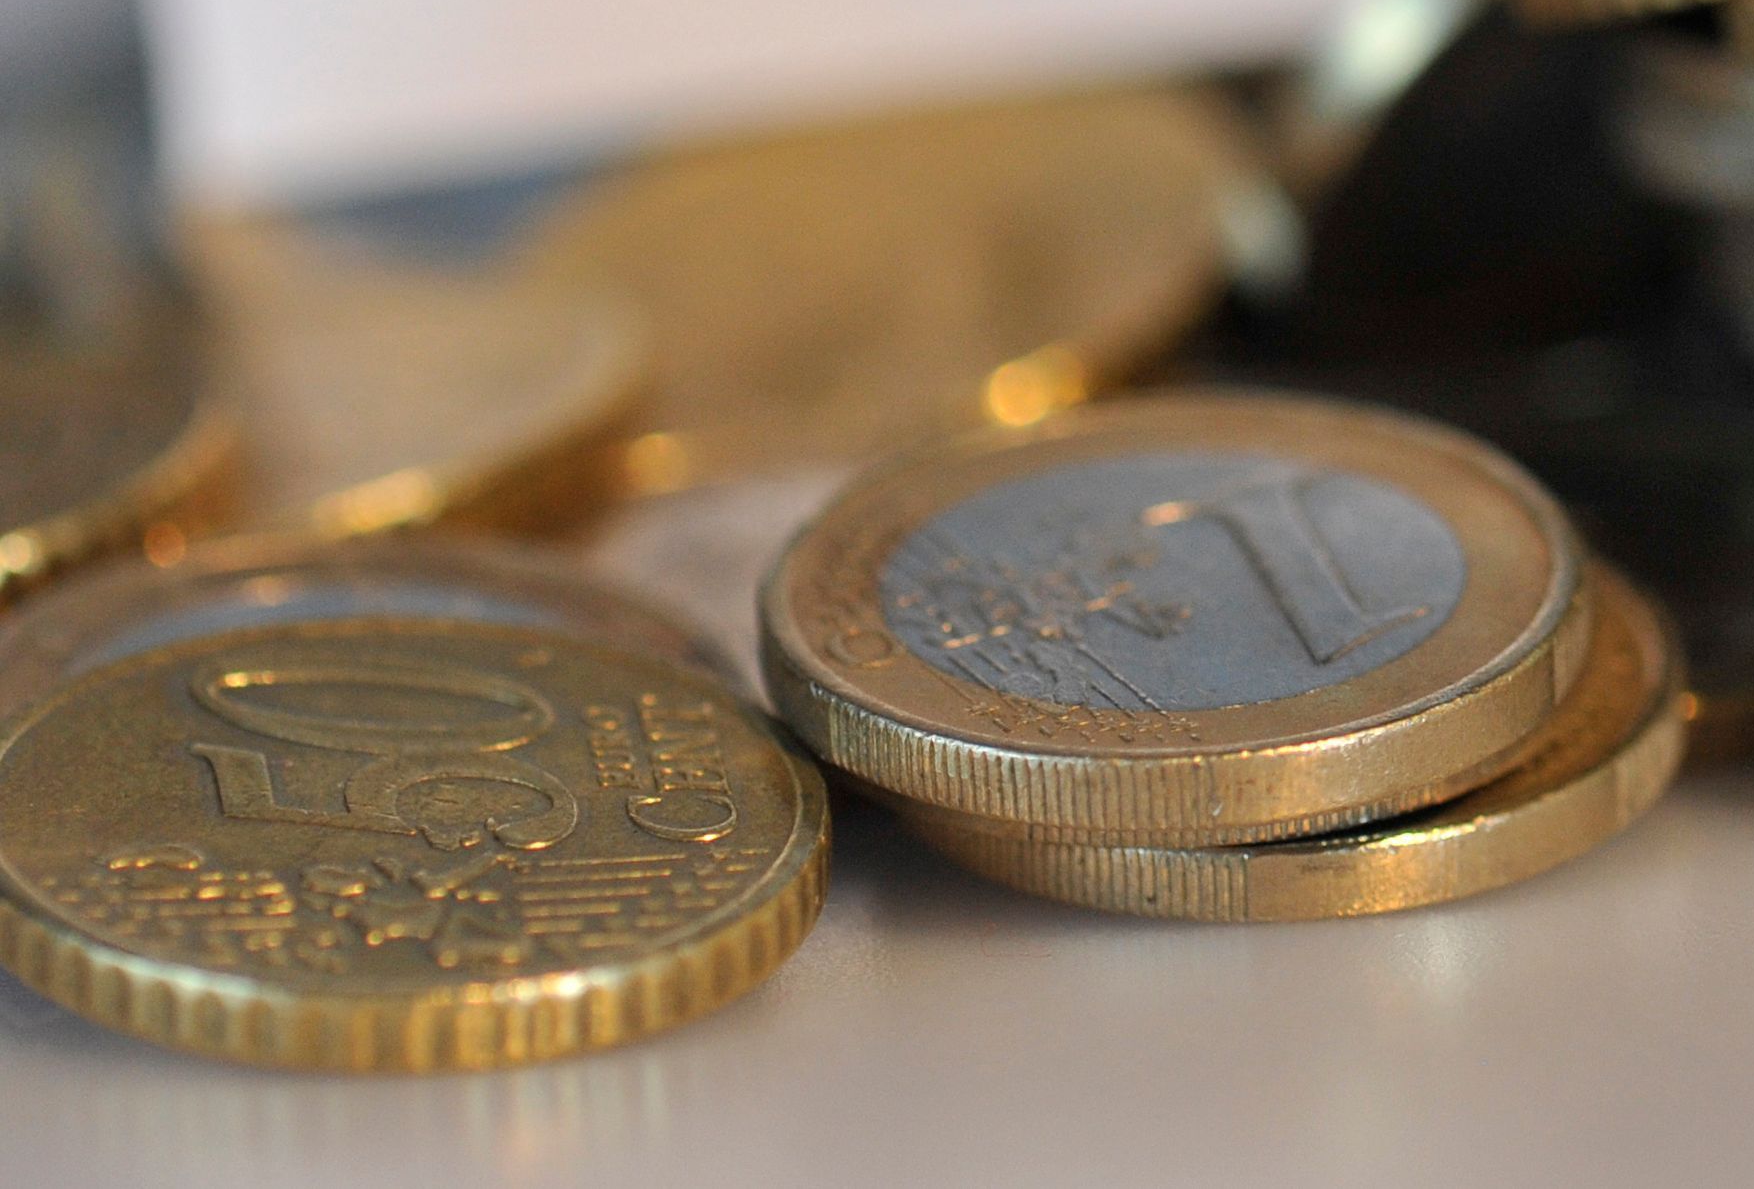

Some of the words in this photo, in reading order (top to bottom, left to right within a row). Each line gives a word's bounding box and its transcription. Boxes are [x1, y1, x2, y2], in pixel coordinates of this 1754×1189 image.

[1142, 470, 1430, 667] 1
[188, 666, 579, 850] 50
[626, 693, 738, 842] CENT
